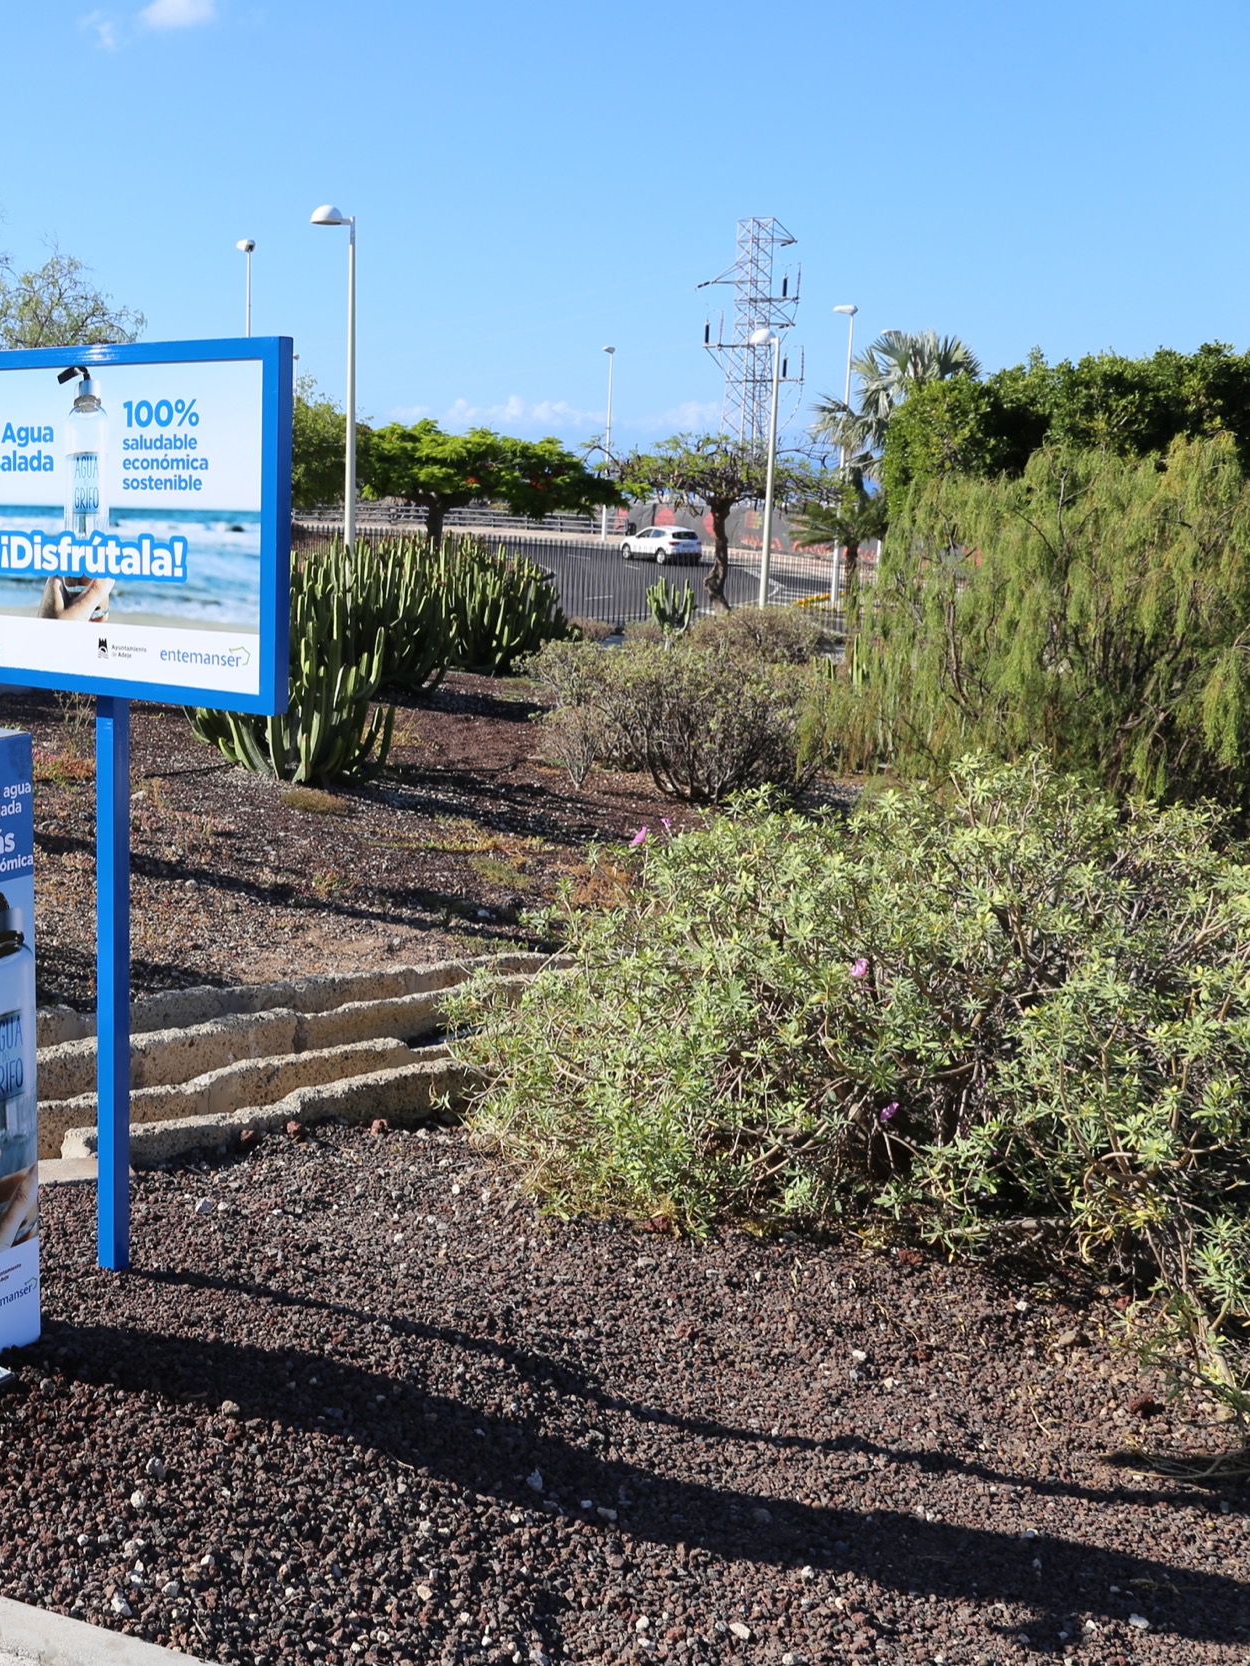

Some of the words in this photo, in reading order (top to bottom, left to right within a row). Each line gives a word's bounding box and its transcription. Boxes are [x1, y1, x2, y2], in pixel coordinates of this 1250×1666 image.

[122, 398, 200, 428] 100%
[1, 422, 54, 447] Agua
[122, 433, 198, 451] saludable
[74, 456, 100, 479] AGUA
[122, 452, 209, 471] económica
[122, 474, 203, 491] sostenible
[74, 486, 100, 509] GRIFO
[0, 534, 183, 577] ¡Disfrútala!
[159, 647, 241, 668] entemanser
[3, 781, 31, 799] agua
